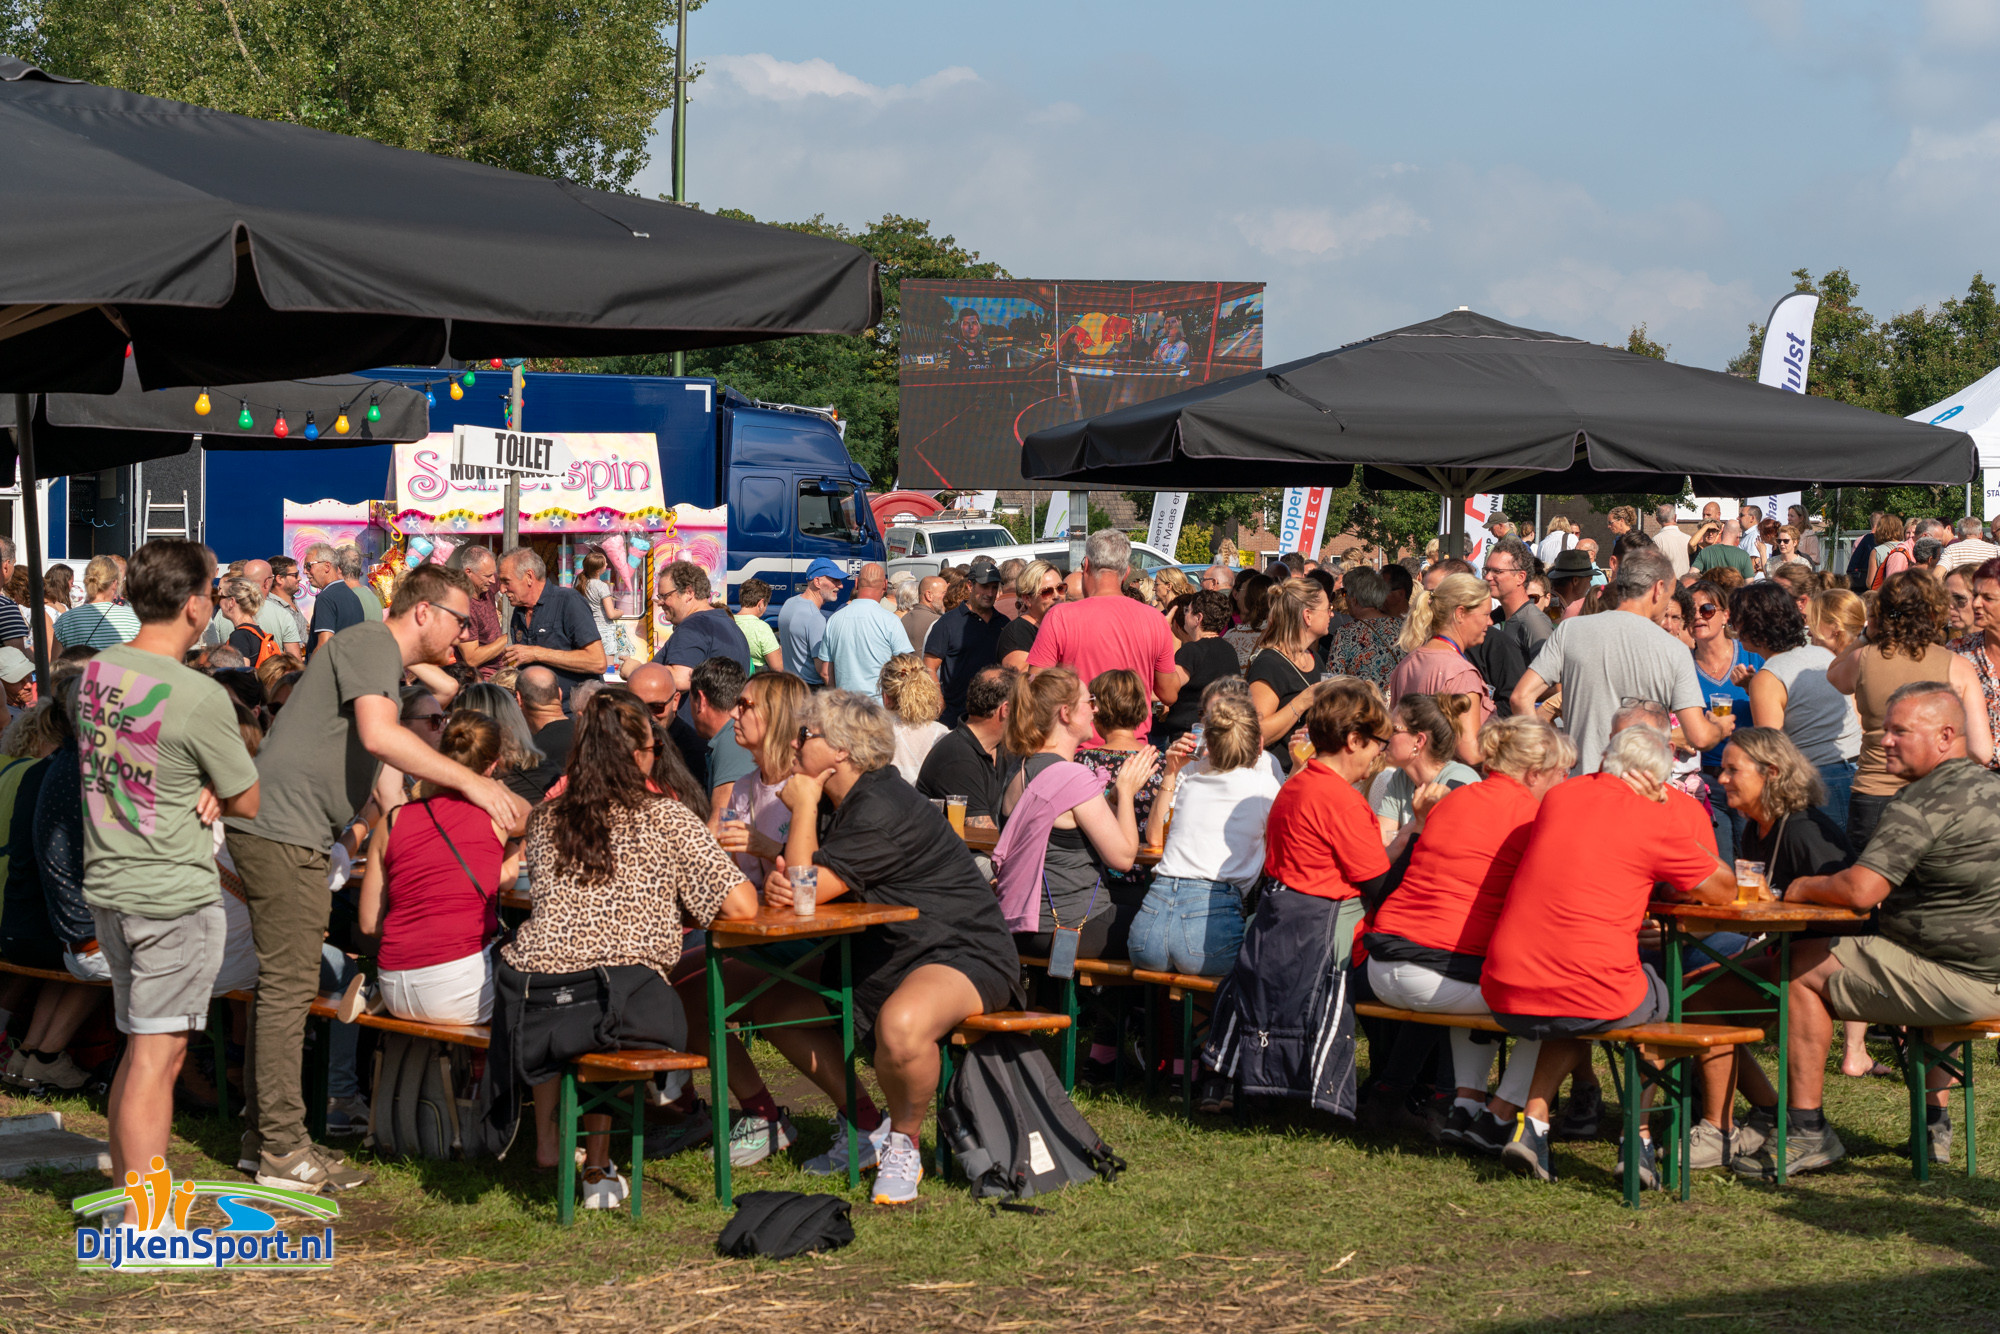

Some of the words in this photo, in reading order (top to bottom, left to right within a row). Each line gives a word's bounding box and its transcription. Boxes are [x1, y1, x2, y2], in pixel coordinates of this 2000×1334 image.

[495, 432, 553, 470] TOILET
[1163, 508, 1178, 540] Maas
[78, 679, 124, 710] OVE,
[79, 748, 153, 786] ANDOM
